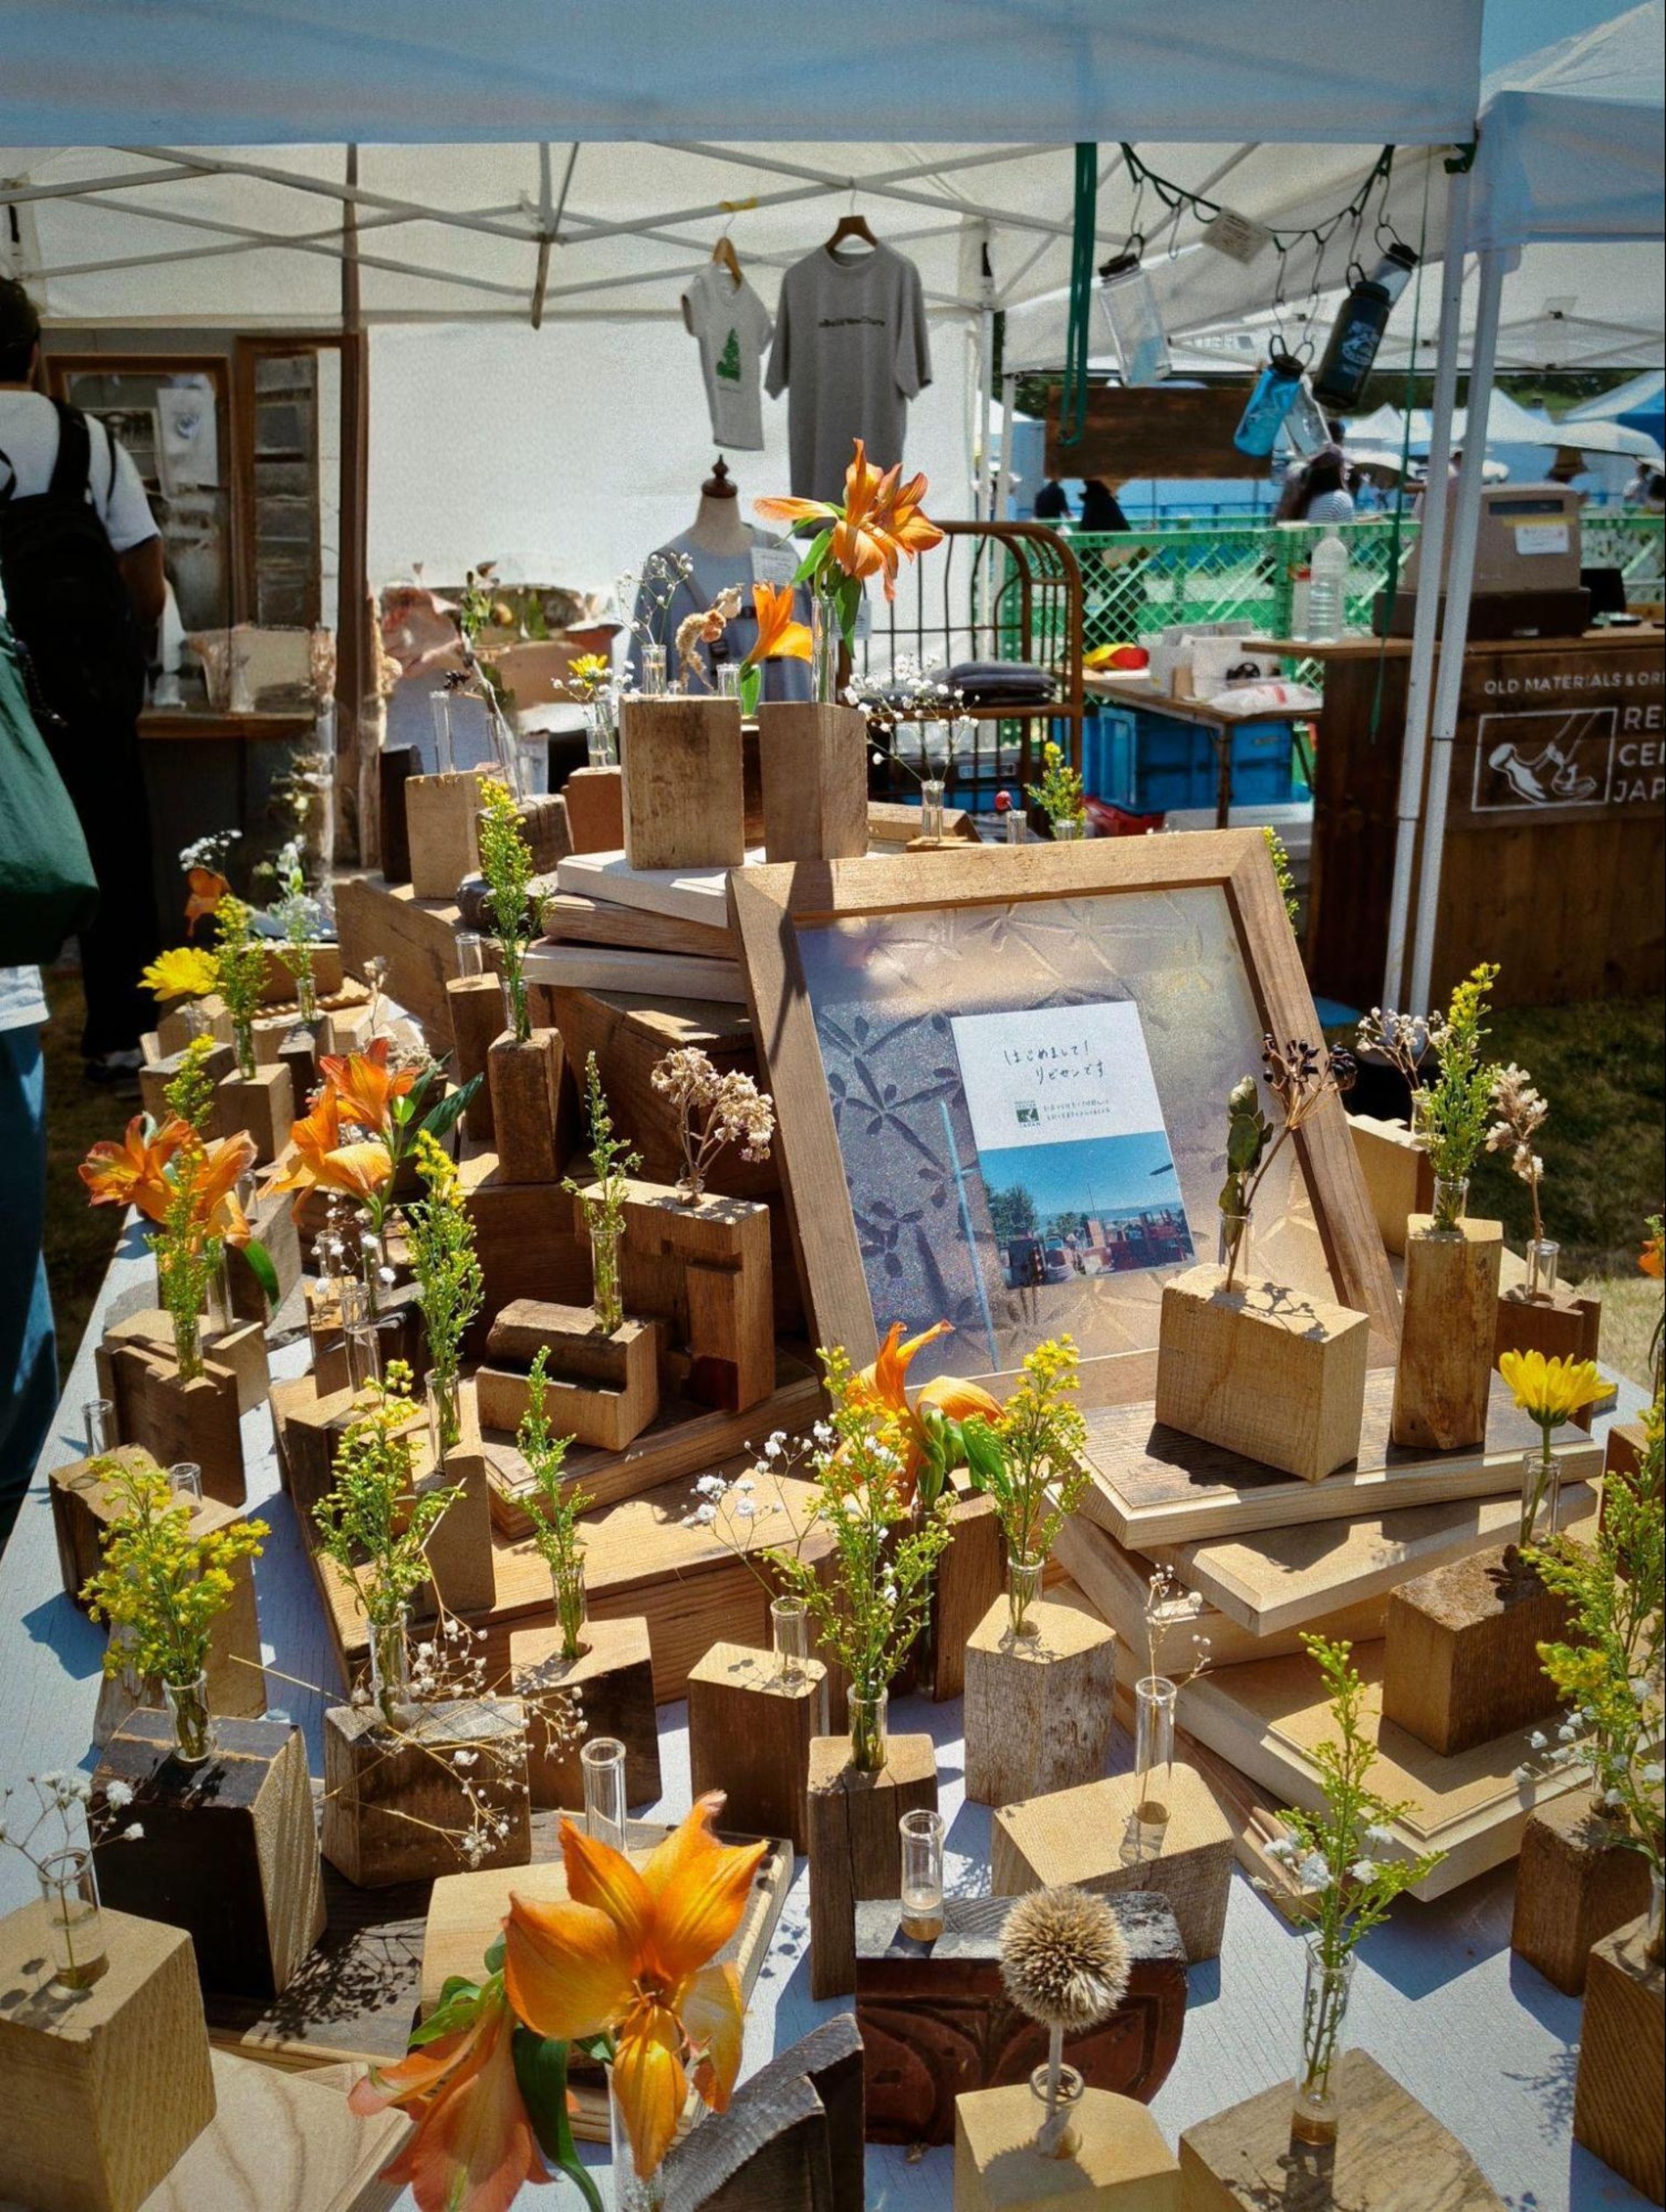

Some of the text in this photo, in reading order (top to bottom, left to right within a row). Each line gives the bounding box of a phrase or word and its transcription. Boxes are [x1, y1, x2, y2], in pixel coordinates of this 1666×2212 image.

[1484, 679, 1519, 694] OLD
[1525, 673, 1621, 693] MATERIALS
[1624, 704, 1665, 730] RE
